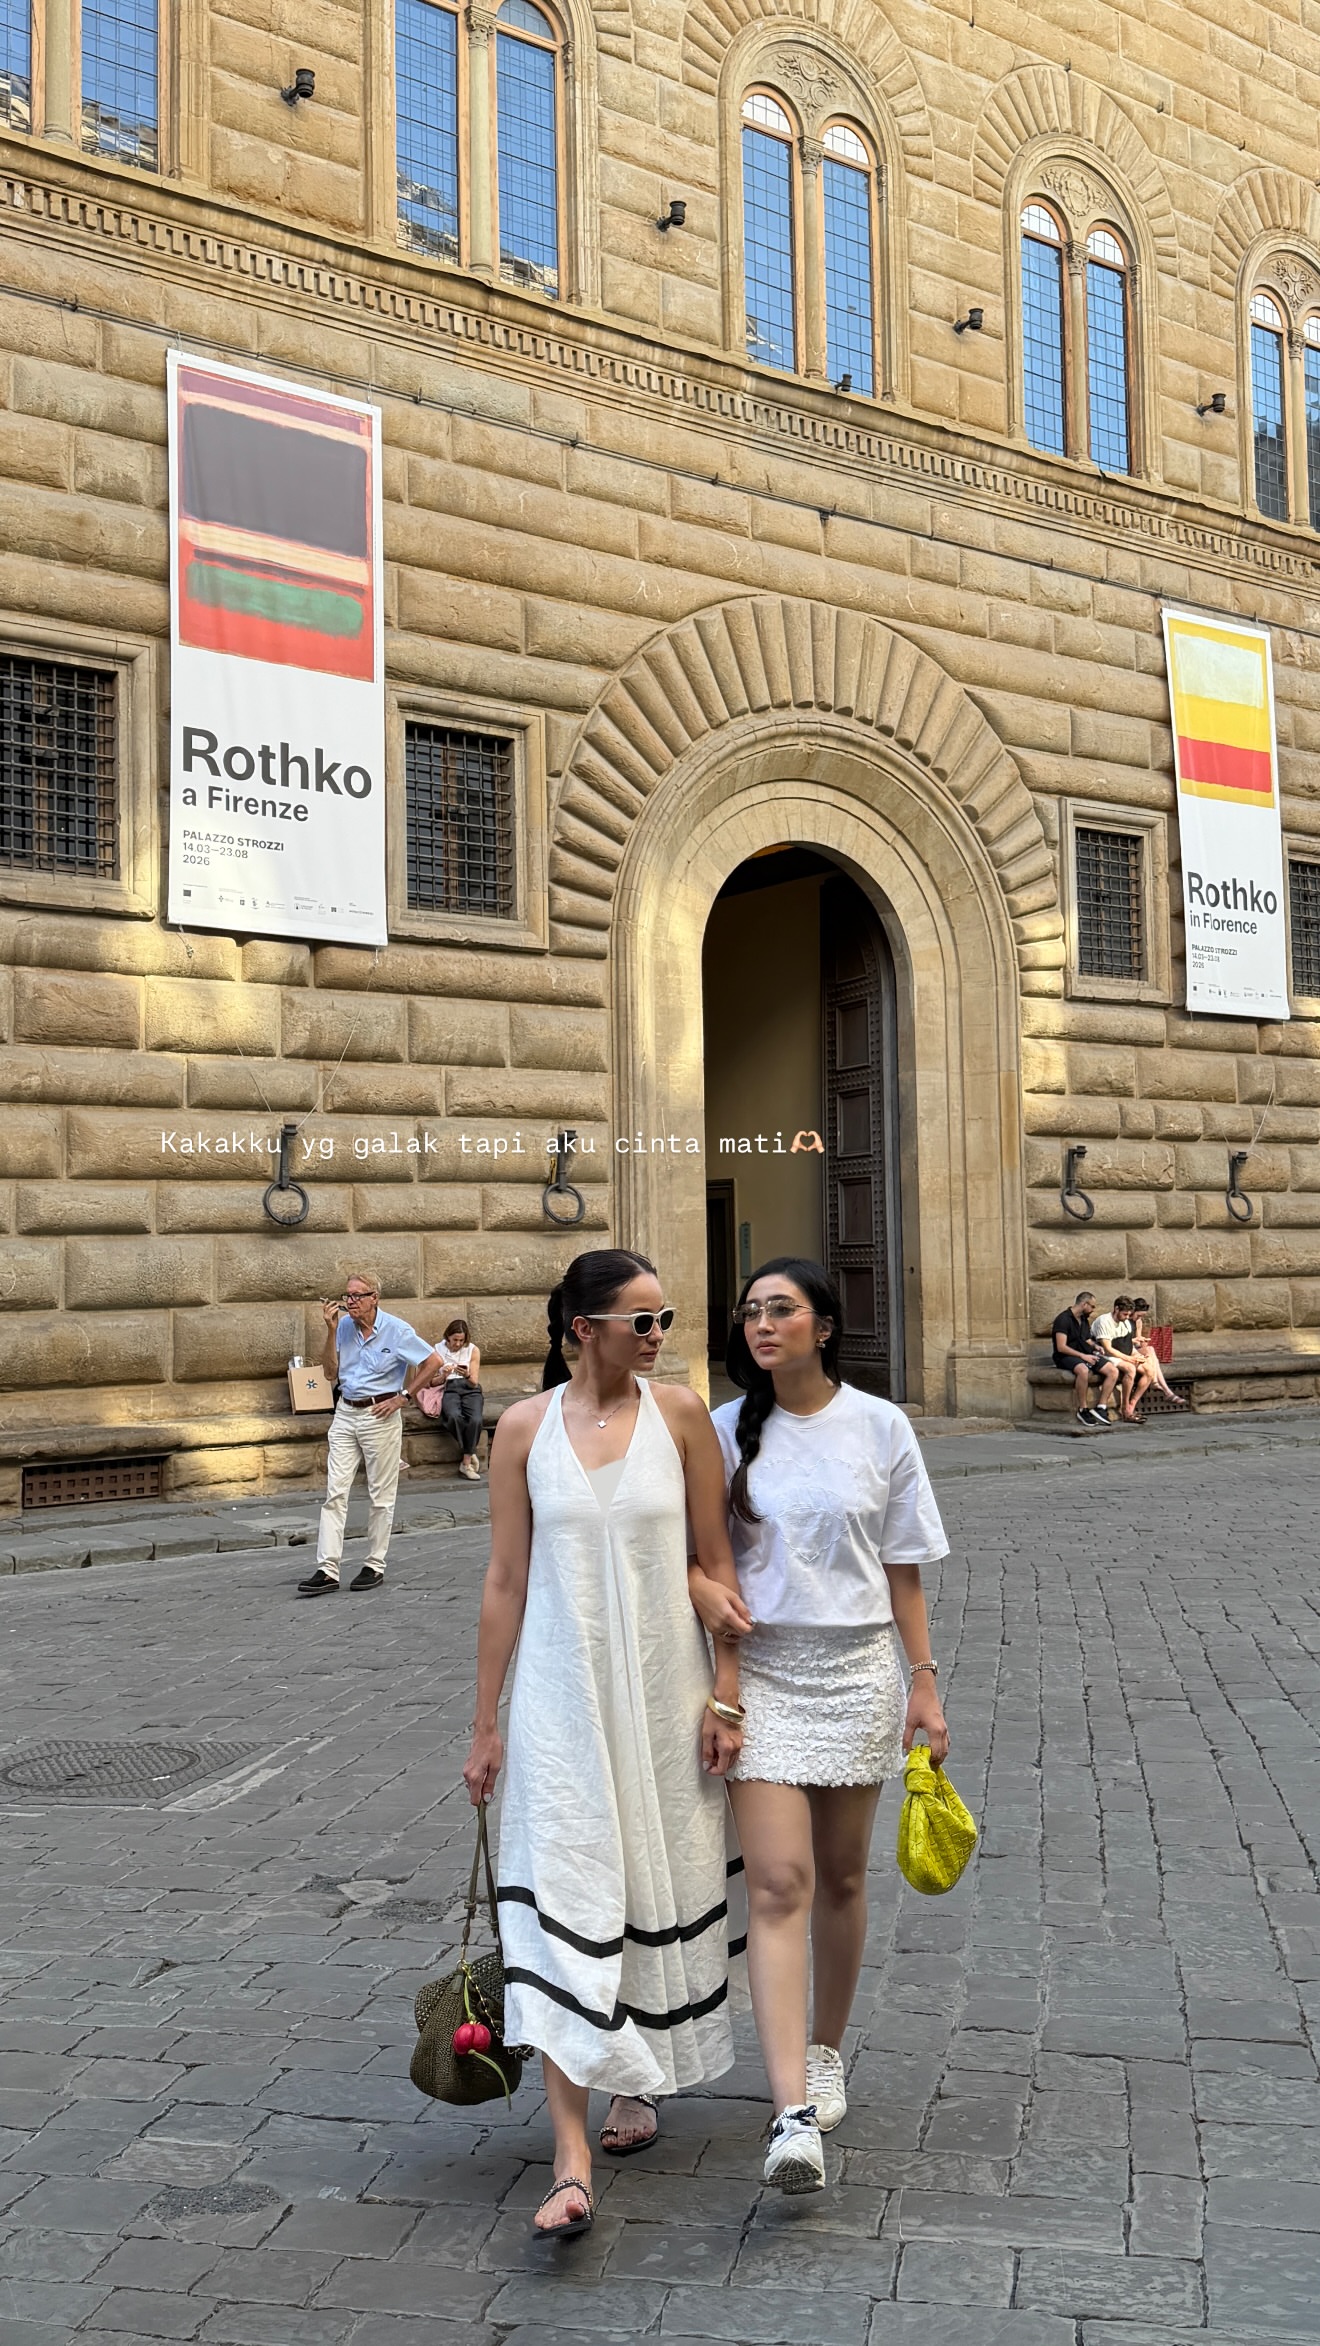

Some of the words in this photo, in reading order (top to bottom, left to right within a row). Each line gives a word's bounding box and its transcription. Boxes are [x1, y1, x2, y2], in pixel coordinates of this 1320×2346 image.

[183, 726, 372, 799] Rothko
[182, 787, 197, 807] a
[208, 785, 309, 822] Firenze
[183, 829, 235, 845] PALAZZO
[237, 837, 284, 852] STROZZI
[182, 854, 210, 866] 2026
[1187, 871, 1277, 914] Rothko
[1190, 910, 1200, 927] in
[1203, 912, 1257, 934] Florence
